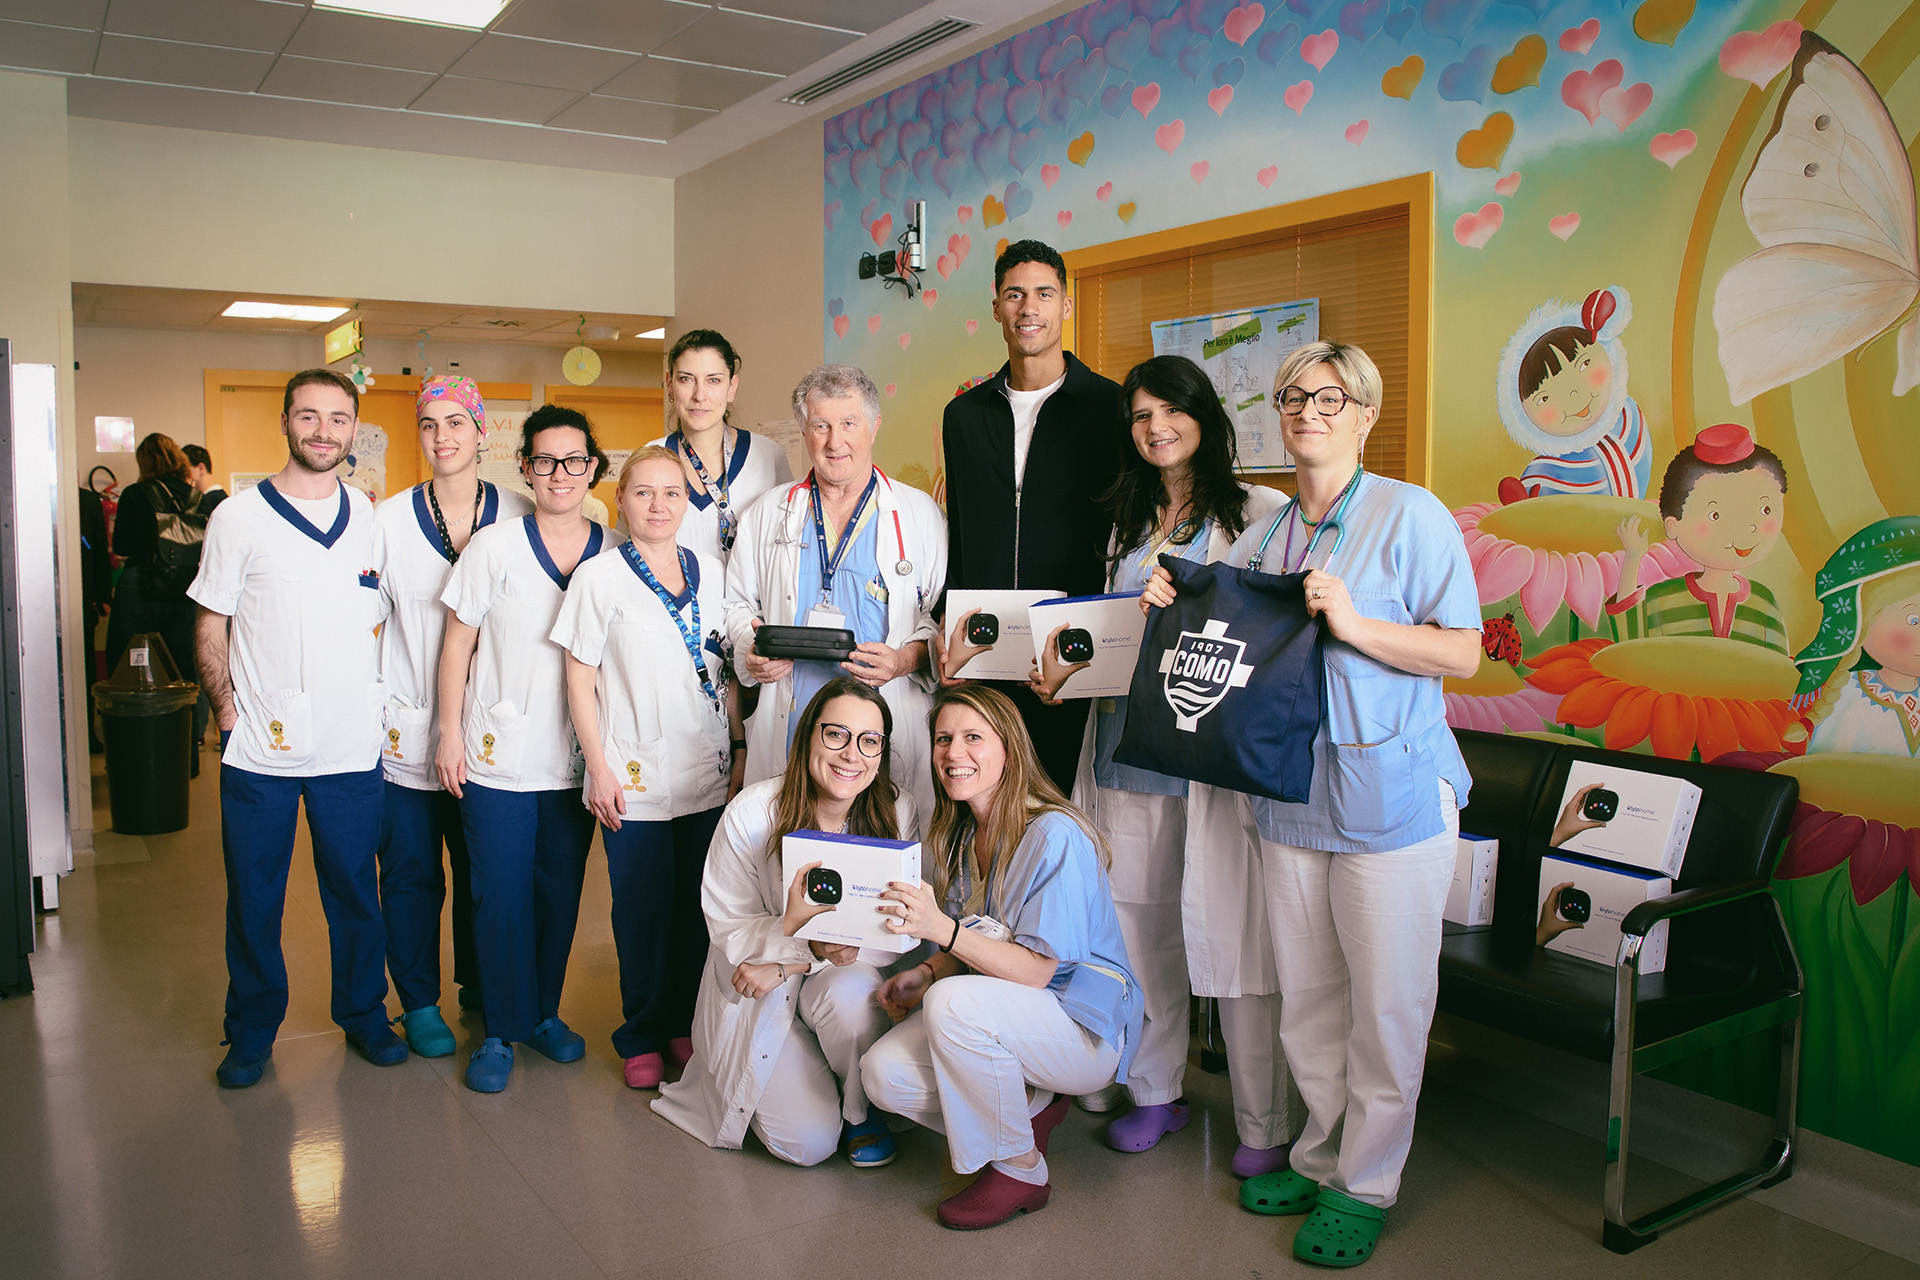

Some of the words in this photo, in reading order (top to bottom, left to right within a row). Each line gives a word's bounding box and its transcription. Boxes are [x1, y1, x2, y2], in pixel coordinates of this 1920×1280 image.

[1203, 338, 1215, 348] Per
[1215, 336, 1228, 347] loro
[1229, 334, 1234, 345] è
[1235, 332, 1260, 345] Meglio
[1190, 641, 1224, 655] 1907
[1172, 650, 1232, 684] COMO
